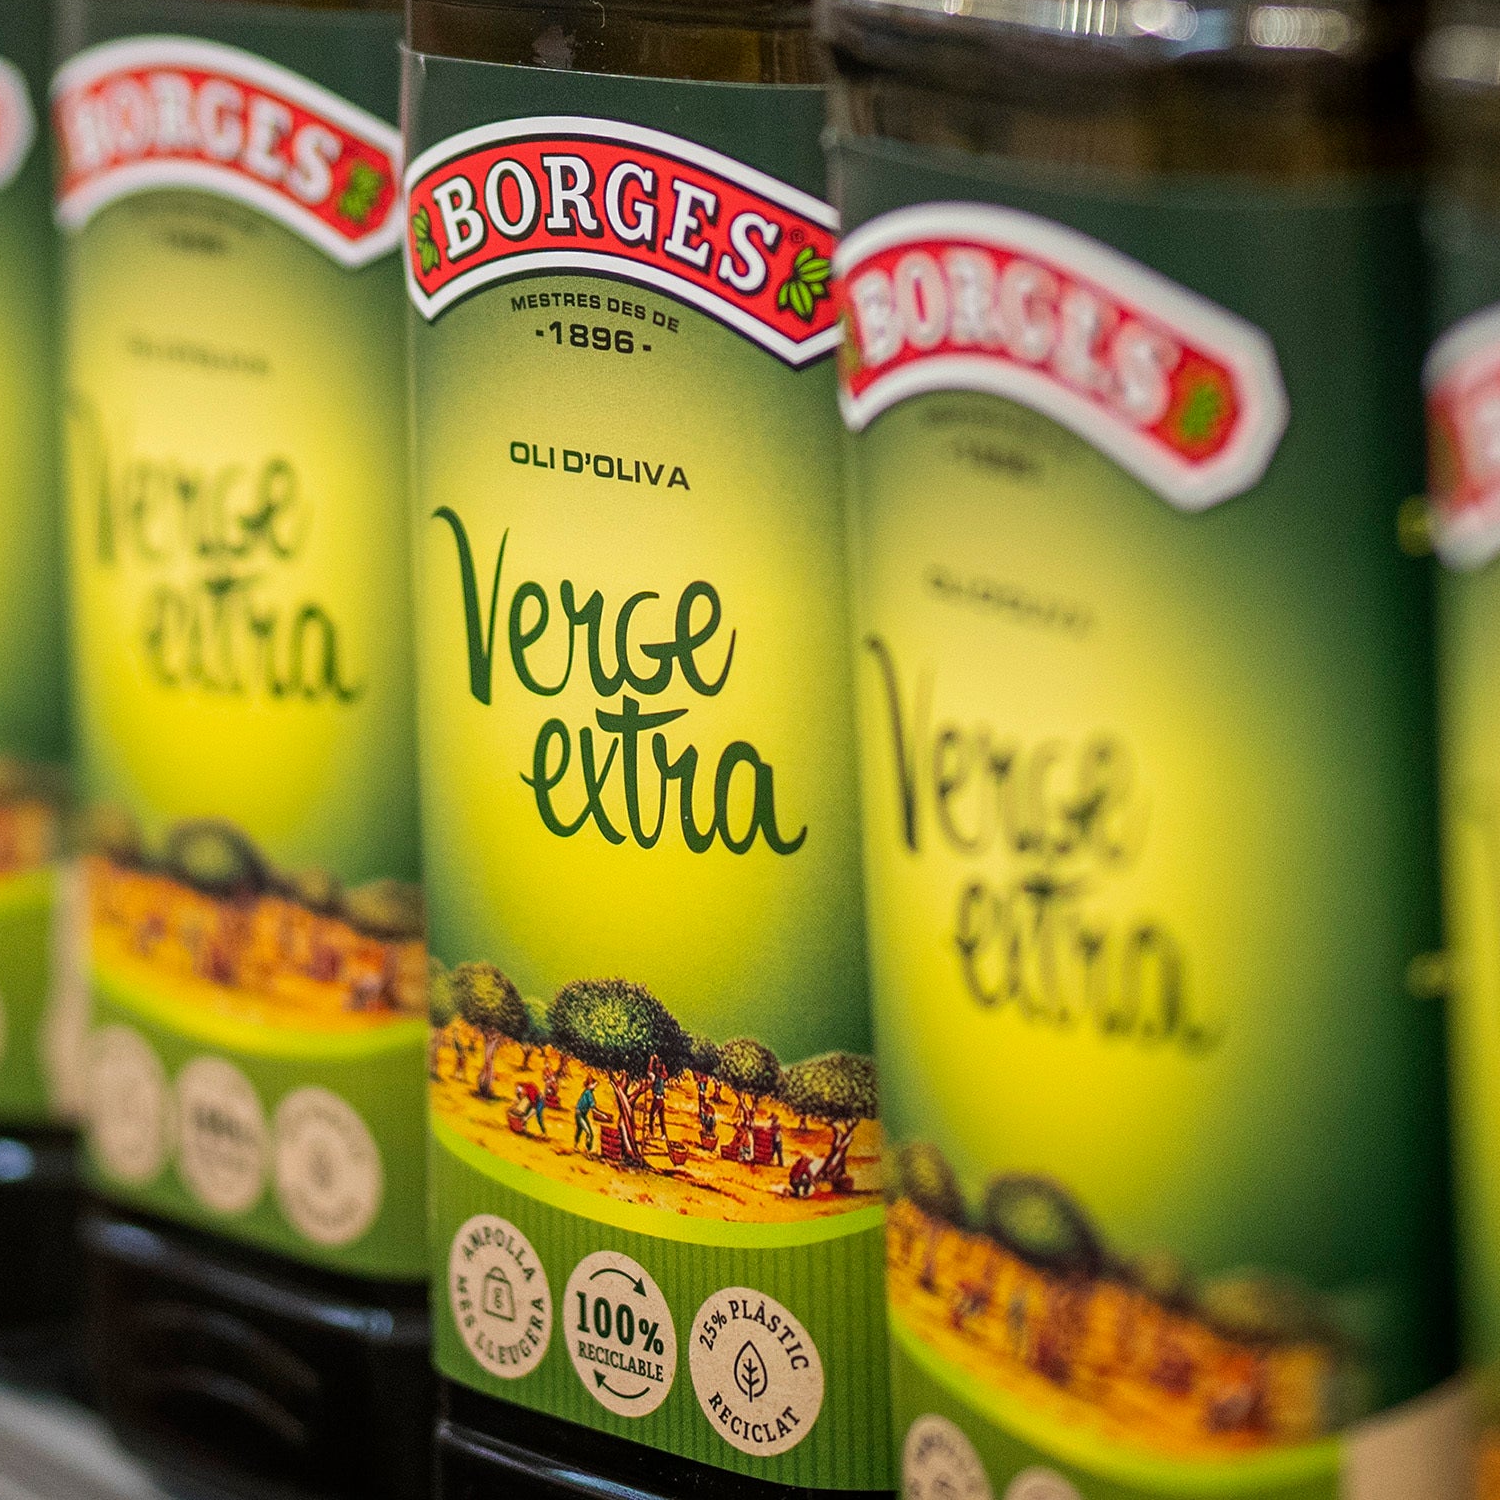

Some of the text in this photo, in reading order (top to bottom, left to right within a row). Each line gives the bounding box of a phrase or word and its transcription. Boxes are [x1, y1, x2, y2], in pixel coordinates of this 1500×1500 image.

[432, 153, 782, 295] BORGES
[511, 292, 680, 333] MESTRES DES DE
[510, 440, 691, 491] OLI D'OLIVA
[431, 505, 737, 706] Verge
[519, 694, 808, 856] extra
[461, 1225, 536, 1283] AMPOLLA
[474, 1296, 546, 1366] LLEUGERA
[576, 1290, 665, 1356] 100%
[699, 1299, 810, 1371] 25% PLÀSTIC
[577, 1340, 665, 1383] RECICLABLE
[707, 1391, 801, 1444] RECICLAT
